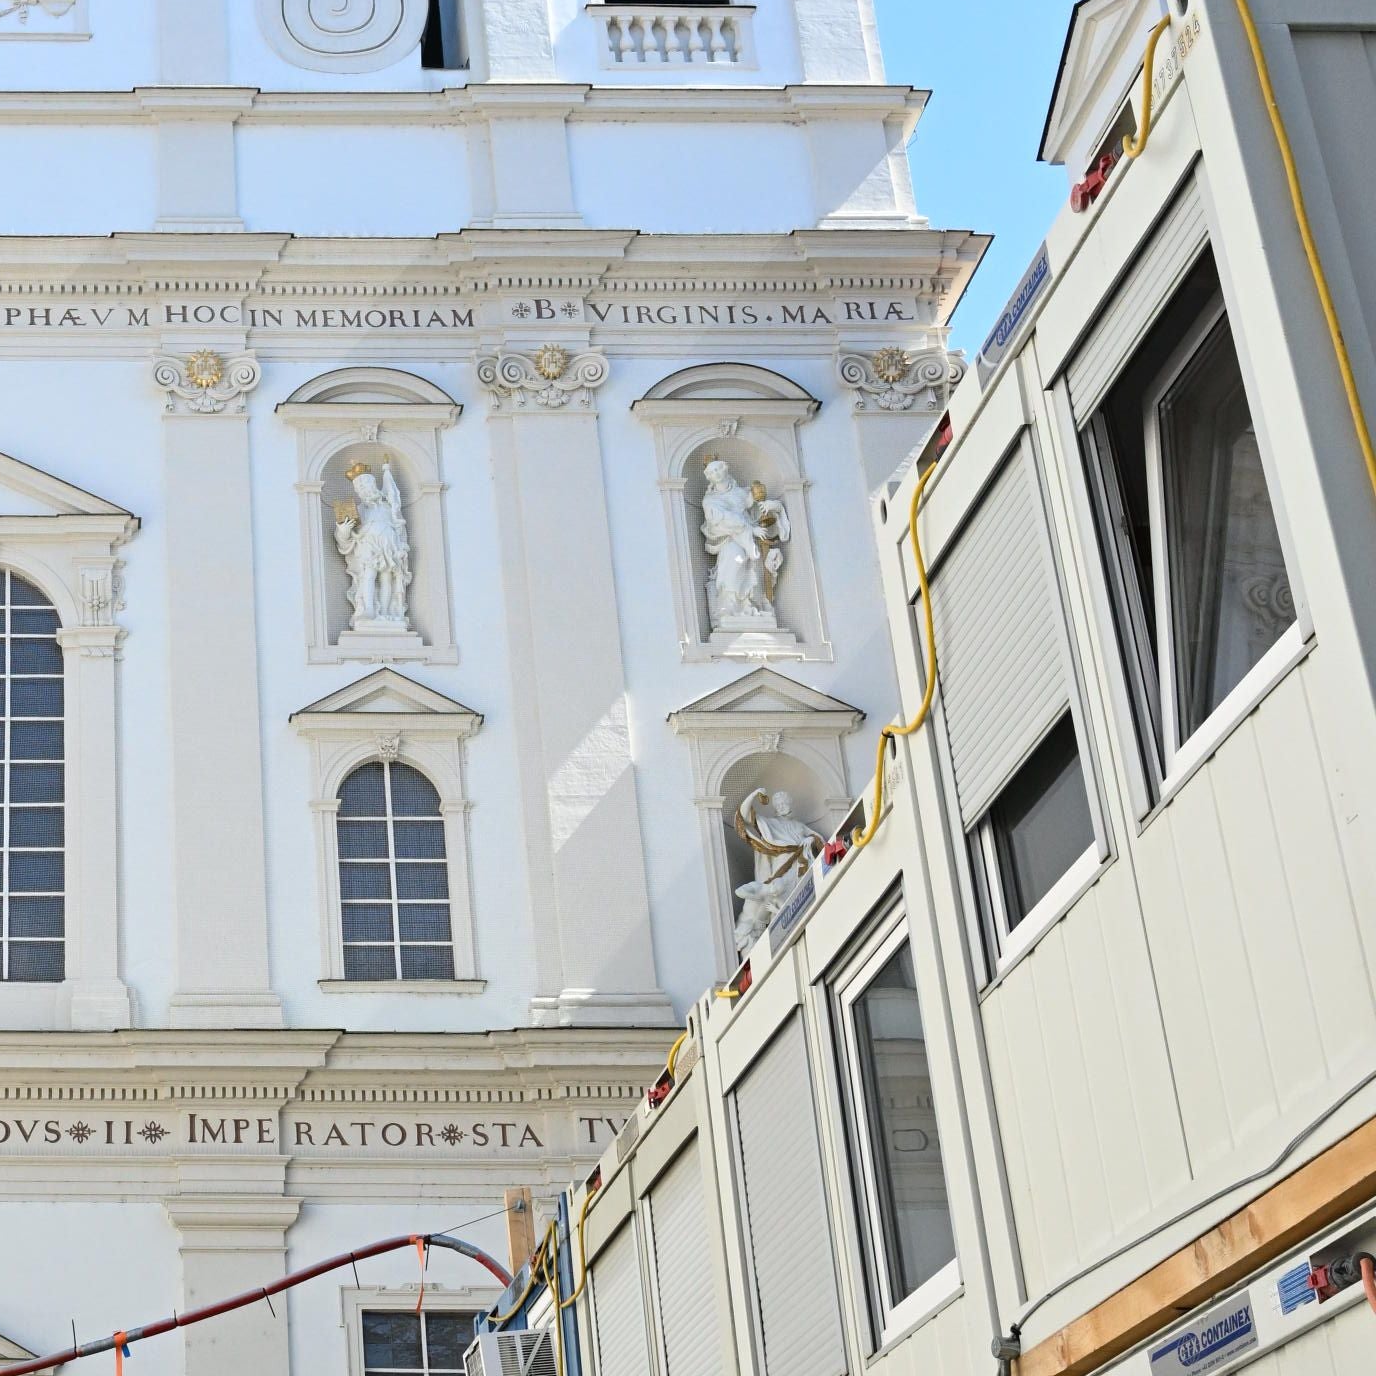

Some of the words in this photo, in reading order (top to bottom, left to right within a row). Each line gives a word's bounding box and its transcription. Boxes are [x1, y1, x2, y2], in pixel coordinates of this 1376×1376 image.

[165, 304, 240, 323] HOC
[248, 308, 284, 328] IN
[295, 308, 474, 328] MEMORIAM
[104, 1120, 135, 1145] II
[1201, 1305, 1251, 1349] CONTAINEX
